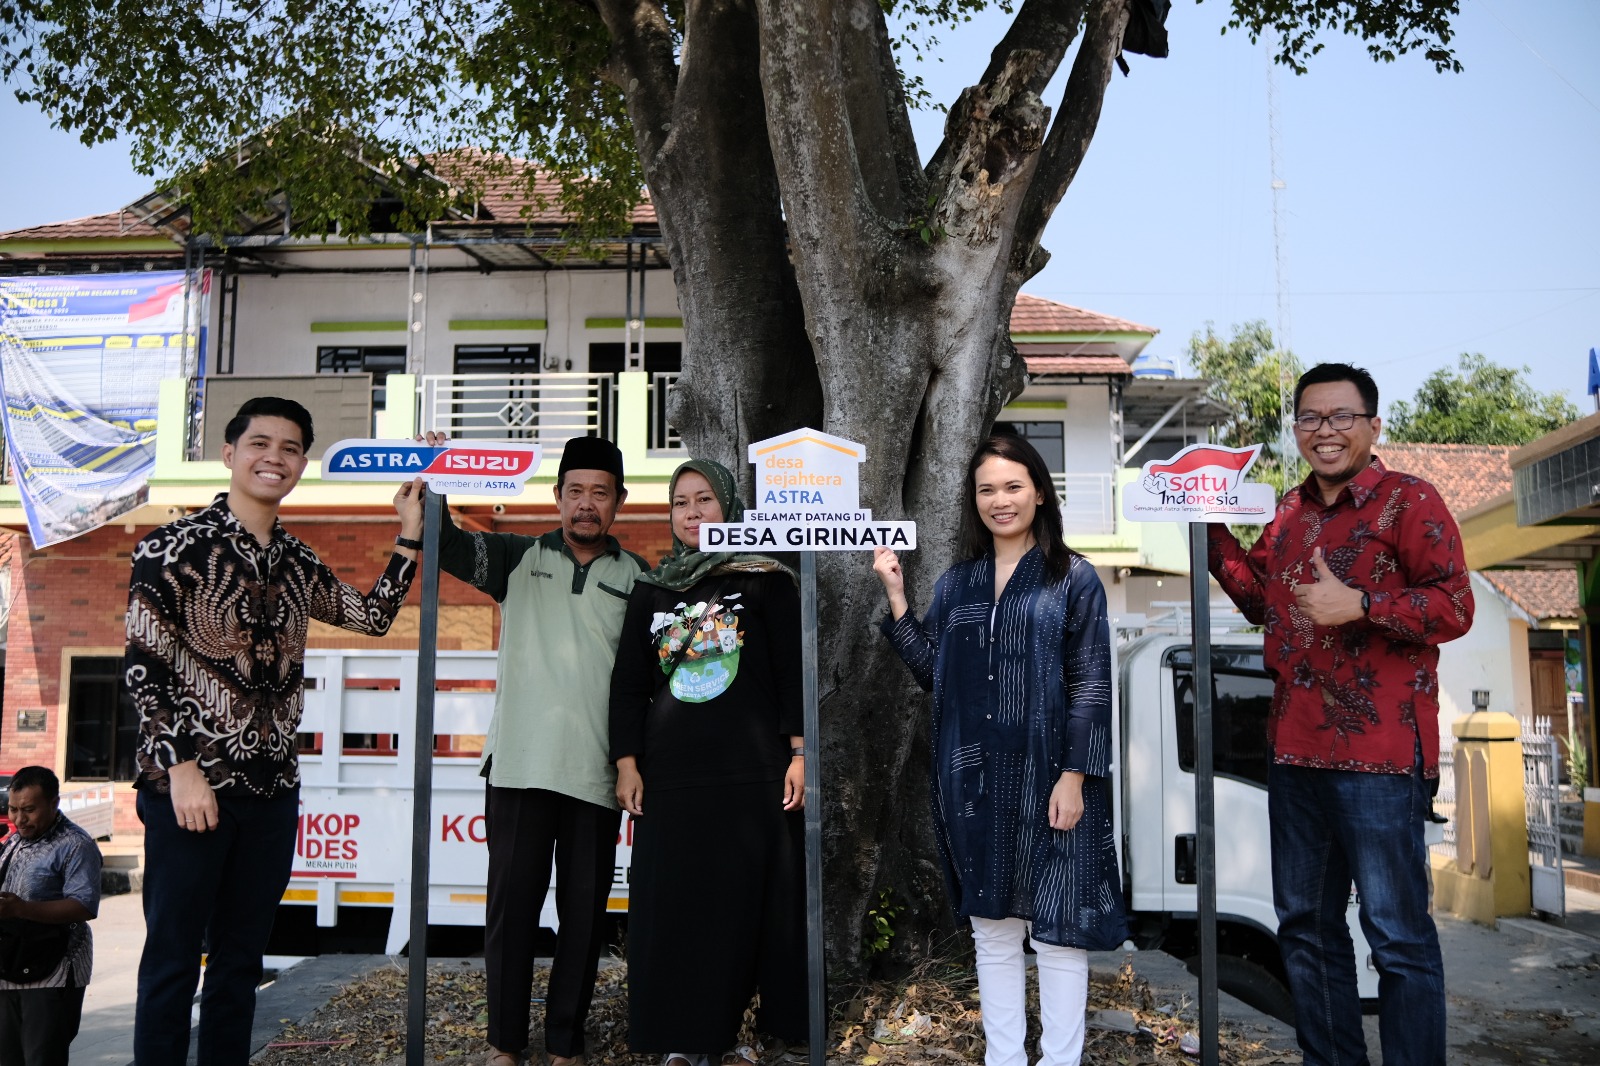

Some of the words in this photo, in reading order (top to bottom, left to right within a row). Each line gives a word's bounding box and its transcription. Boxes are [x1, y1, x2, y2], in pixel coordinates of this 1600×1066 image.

[339, 452, 423, 468] ASTRA
[445, 454, 519, 471] ISUZU
[765, 454, 804, 469] desa
[436, 480, 471, 488] member
[473, 480, 482, 488] of
[485, 481, 516, 489] ASTRA
[765, 471, 842, 488] sejahtera
[1169, 473, 1228, 492] satu
[764, 490, 824, 504] ASTRA
[750, 512, 802, 521] SELAMAT
[805, 512, 851, 521] DATANG
[854, 512, 866, 521] DI
[1133, 504, 1163, 512] Semangat
[708, 527, 777, 546] DESA
[786, 527, 909, 546] GIRINATA
[695, 670, 730, 692] SERVICE
[306, 813, 361, 836] KOP
[306, 839, 358, 860] DES
[306, 860, 333, 868] MERAH
[335, 861, 358, 869] PUTIH
